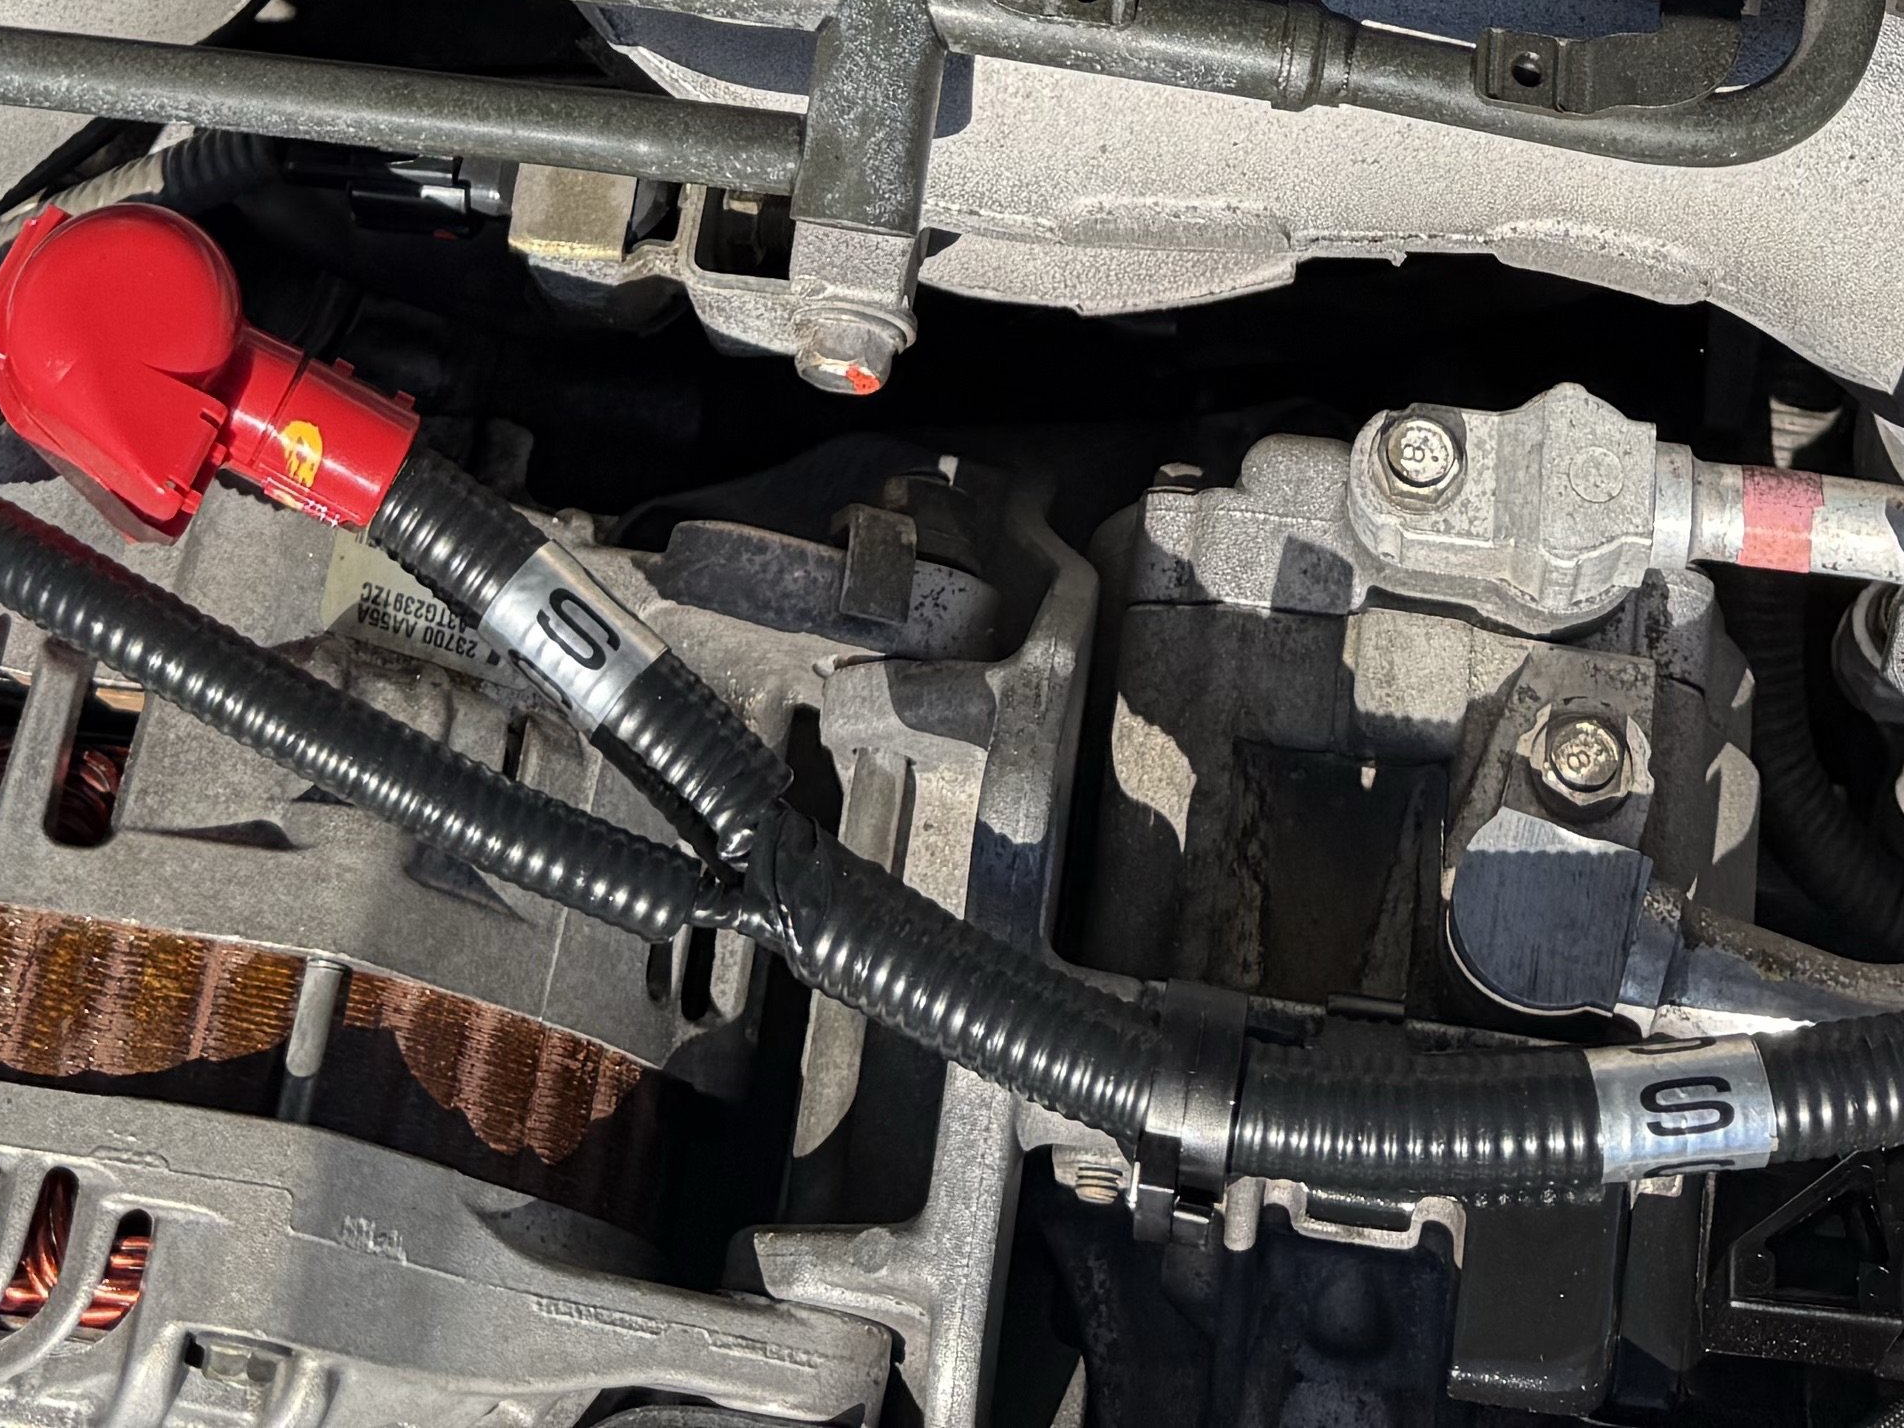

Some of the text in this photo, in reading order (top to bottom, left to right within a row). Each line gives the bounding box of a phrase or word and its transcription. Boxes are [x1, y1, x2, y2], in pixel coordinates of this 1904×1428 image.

[356, 603, 480, 659] 23700 AA55A
[536, 586, 621, 672] S
[1638, 1074, 1734, 1139] S
